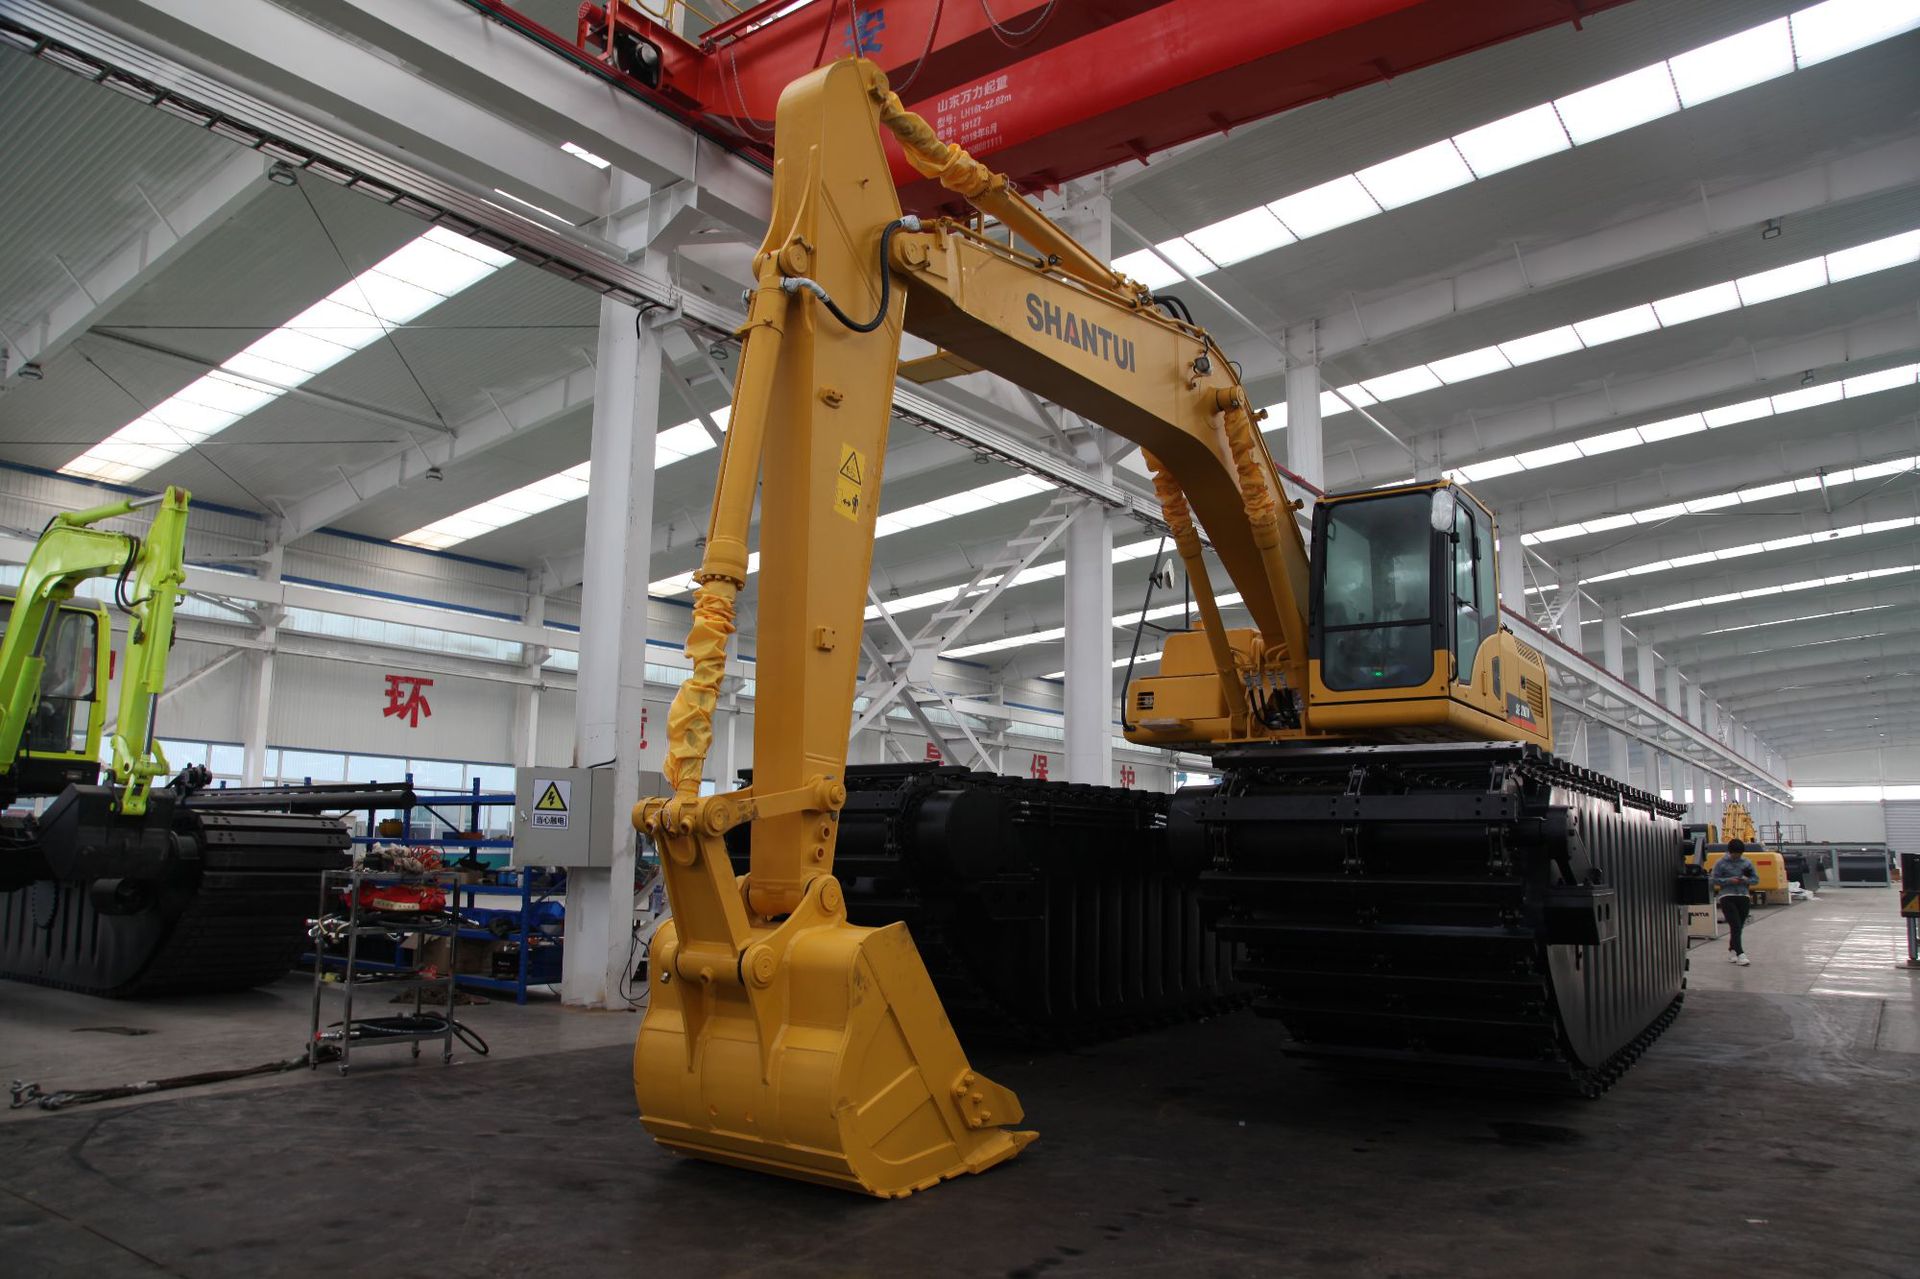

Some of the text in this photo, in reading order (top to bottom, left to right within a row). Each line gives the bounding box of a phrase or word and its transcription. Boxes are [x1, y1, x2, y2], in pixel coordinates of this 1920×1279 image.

[937, 75, 1008, 113] 山东万力起重
[1026, 293, 1136, 373] SHANTUI
[383, 674, 434, 728] 环
[536, 816, 566, 826] 当心触电
